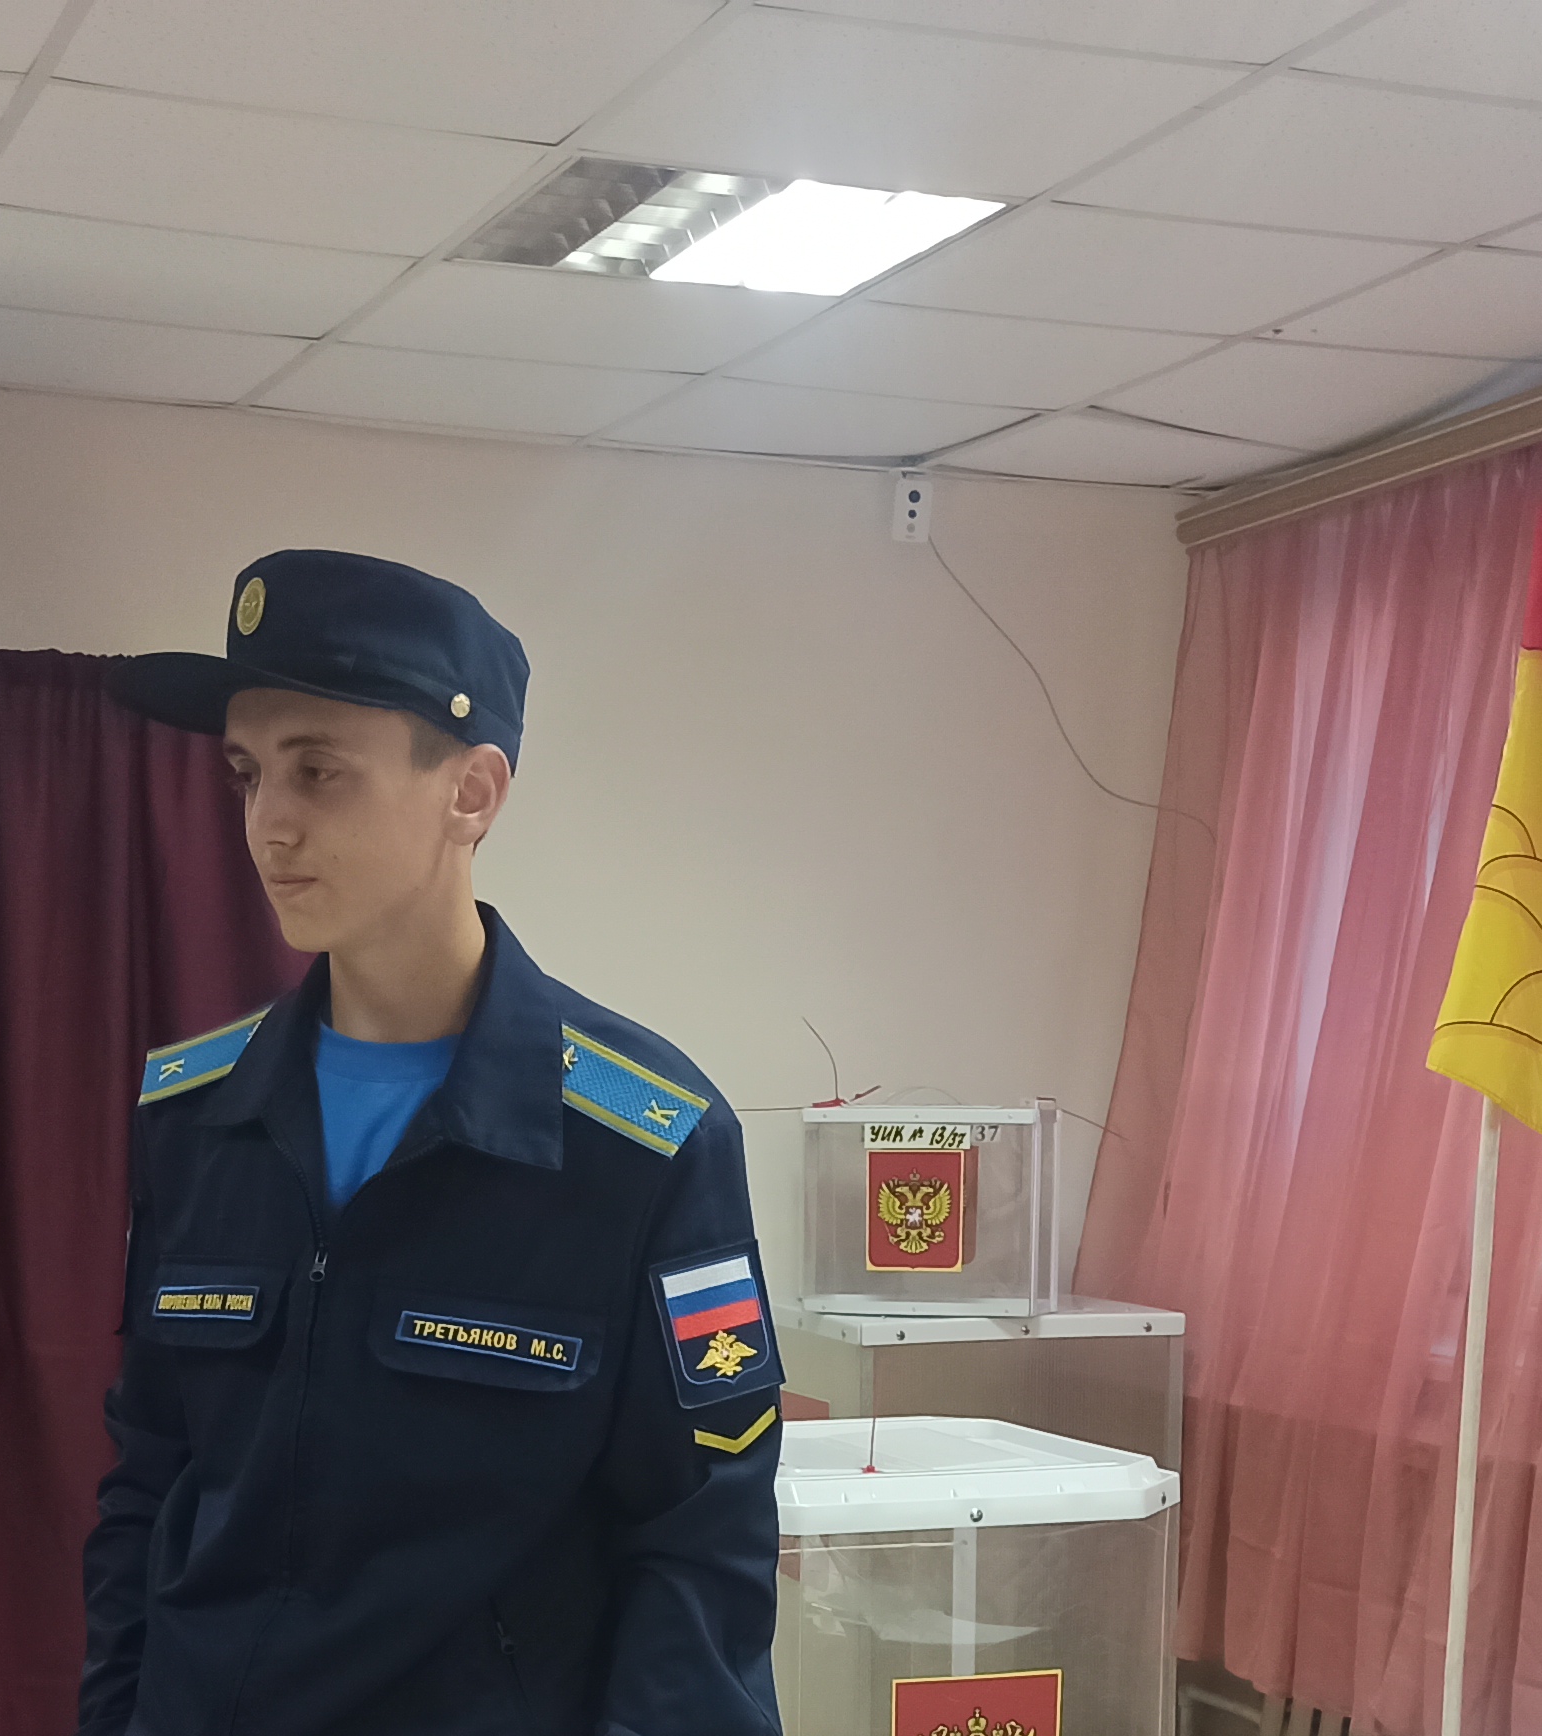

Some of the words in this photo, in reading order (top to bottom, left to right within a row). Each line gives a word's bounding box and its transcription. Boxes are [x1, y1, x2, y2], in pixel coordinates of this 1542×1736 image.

[869, 1124, 905, 1142] УИК
[412, 1319, 518, 1351] ТРЕТЬЯКОВ
[529, 1338, 568, 1362] М.С.
